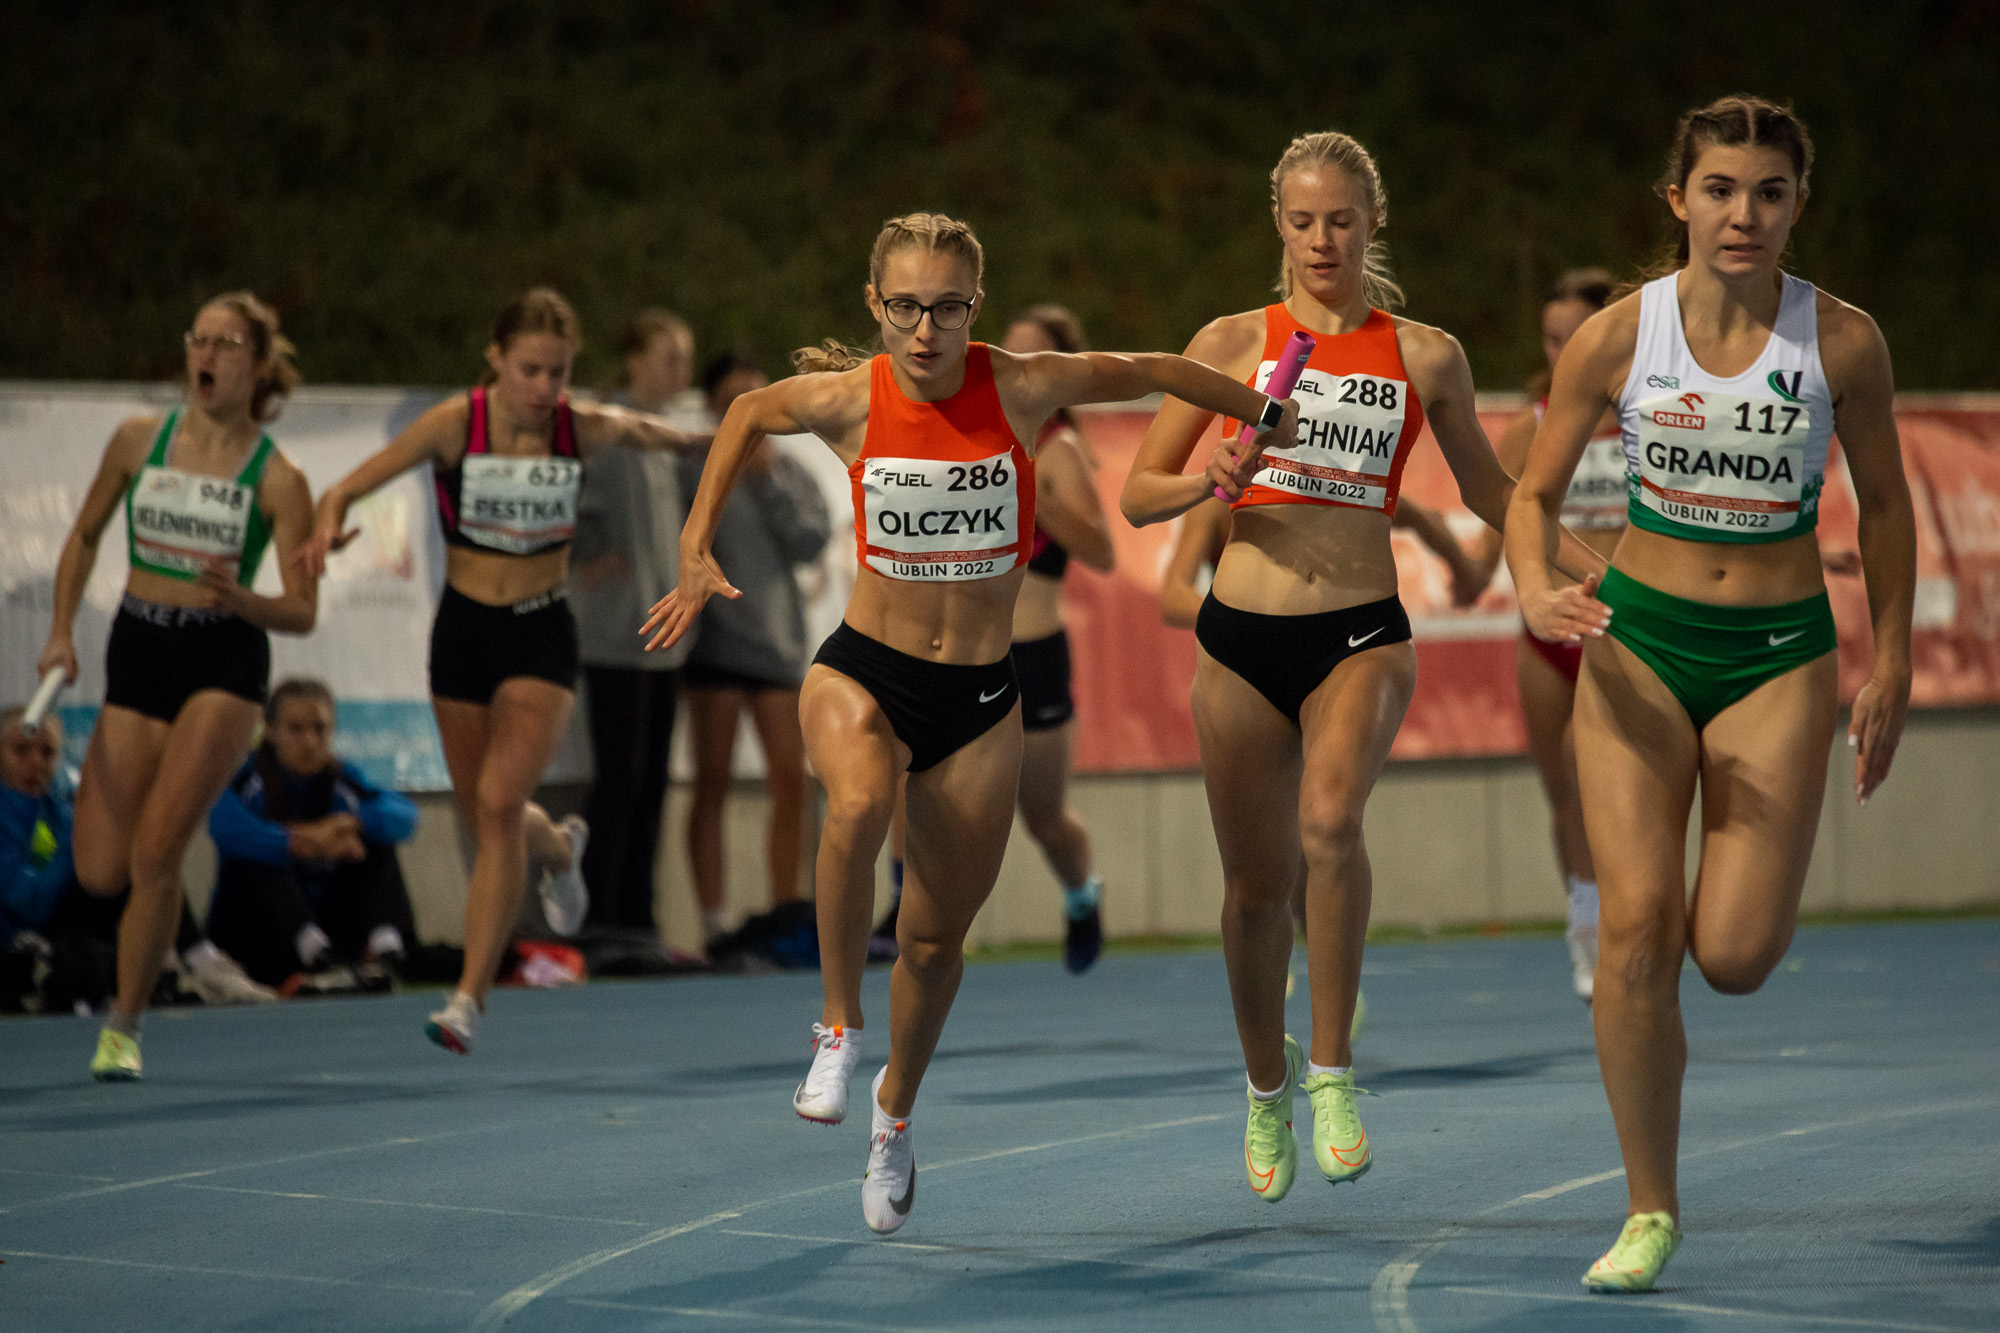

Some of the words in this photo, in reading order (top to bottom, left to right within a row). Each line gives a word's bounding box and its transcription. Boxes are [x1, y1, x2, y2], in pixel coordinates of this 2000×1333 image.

[1338, 378, 1397, 411] 288
[1655, 412, 1703, 429] ORLEN
[1735, 401, 1801, 436] 117
[1298, 417, 1395, 459] CHNIAK
[947, 459, 1009, 492] 286
[1645, 441, 1794, 484] GRANDA
[883, 472, 932, 488] FUEL
[1269, 470, 1323, 493] LUBLIN
[1327, 481, 1366, 500] 2022
[878, 505, 1006, 537] OLCZYK
[1661, 501, 1720, 524] LUBLIN
[1725, 511, 1770, 528] 2022
[892, 562, 947, 577] LUBLIN
[954, 560, 994, 576] 2022
